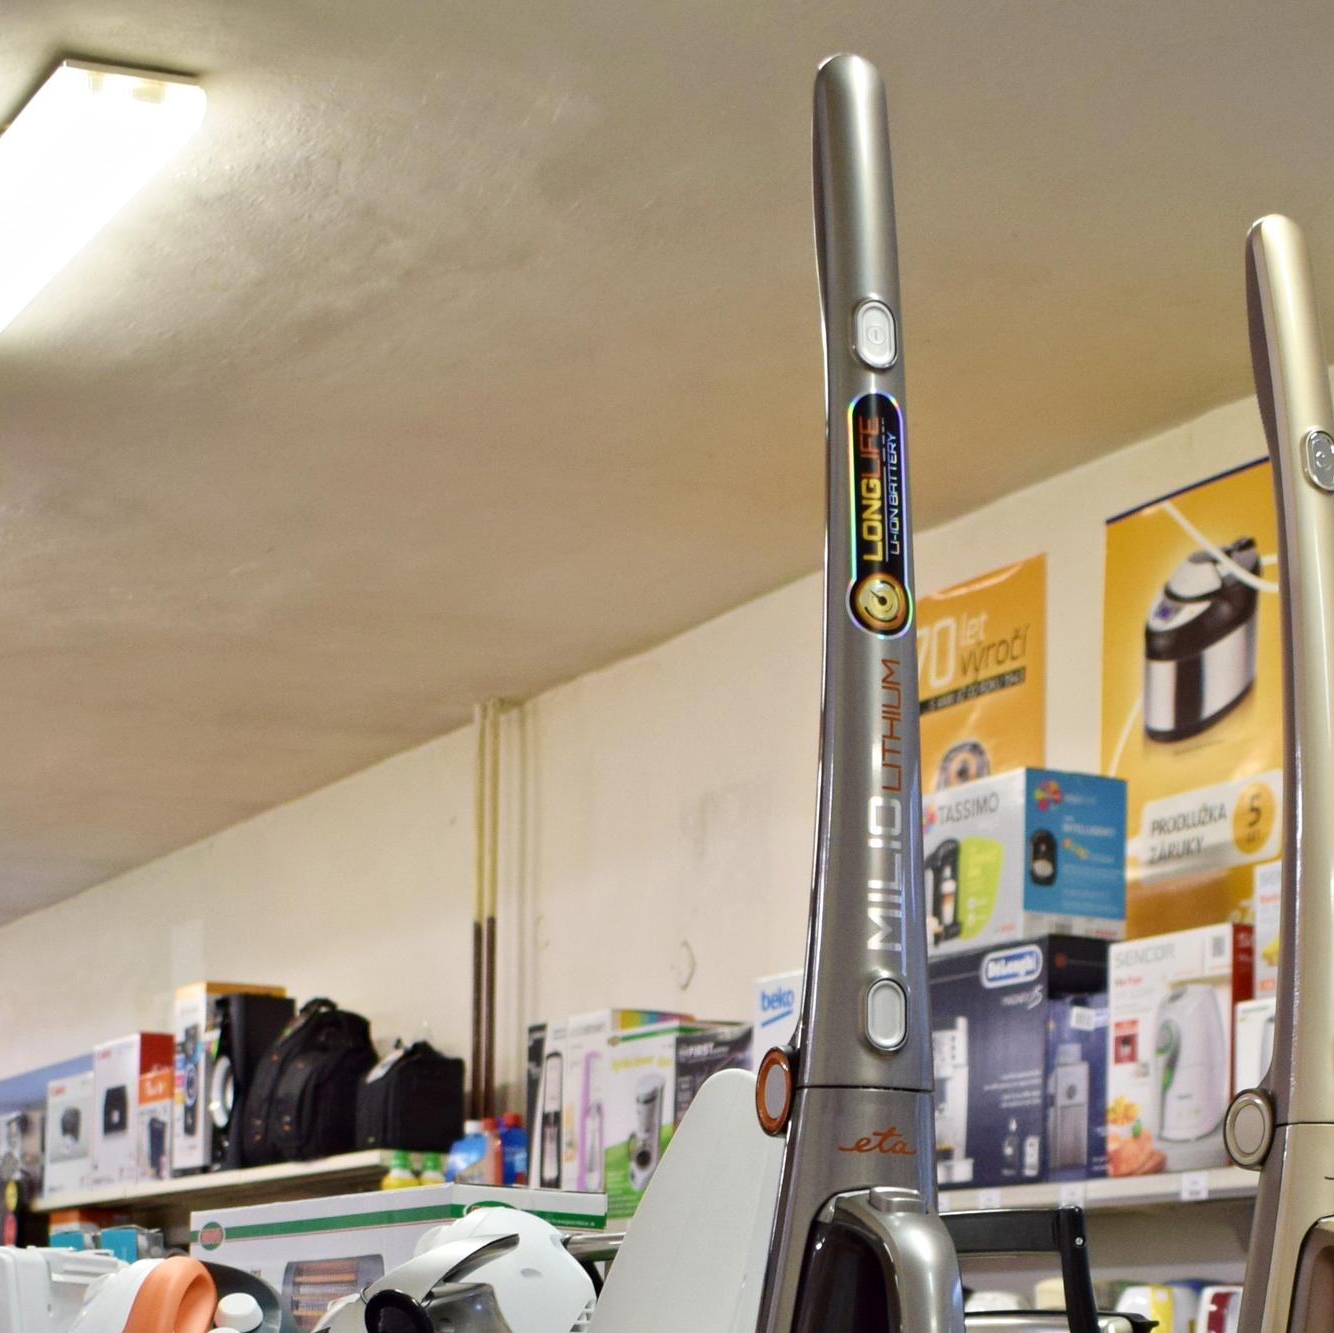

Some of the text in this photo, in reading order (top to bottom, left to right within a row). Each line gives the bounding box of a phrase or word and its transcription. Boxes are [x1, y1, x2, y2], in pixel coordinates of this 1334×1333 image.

[887, 431, 898, 503] BATTERY
[959, 611, 988, 647] let
[881, 658, 902, 793] LITHIUM
[937, 790, 1000, 825] TASSIMO
[1248, 793, 1262, 828] 5
[761, 986, 795, 1013] beko
[838, 1127, 917, 1157] eta
